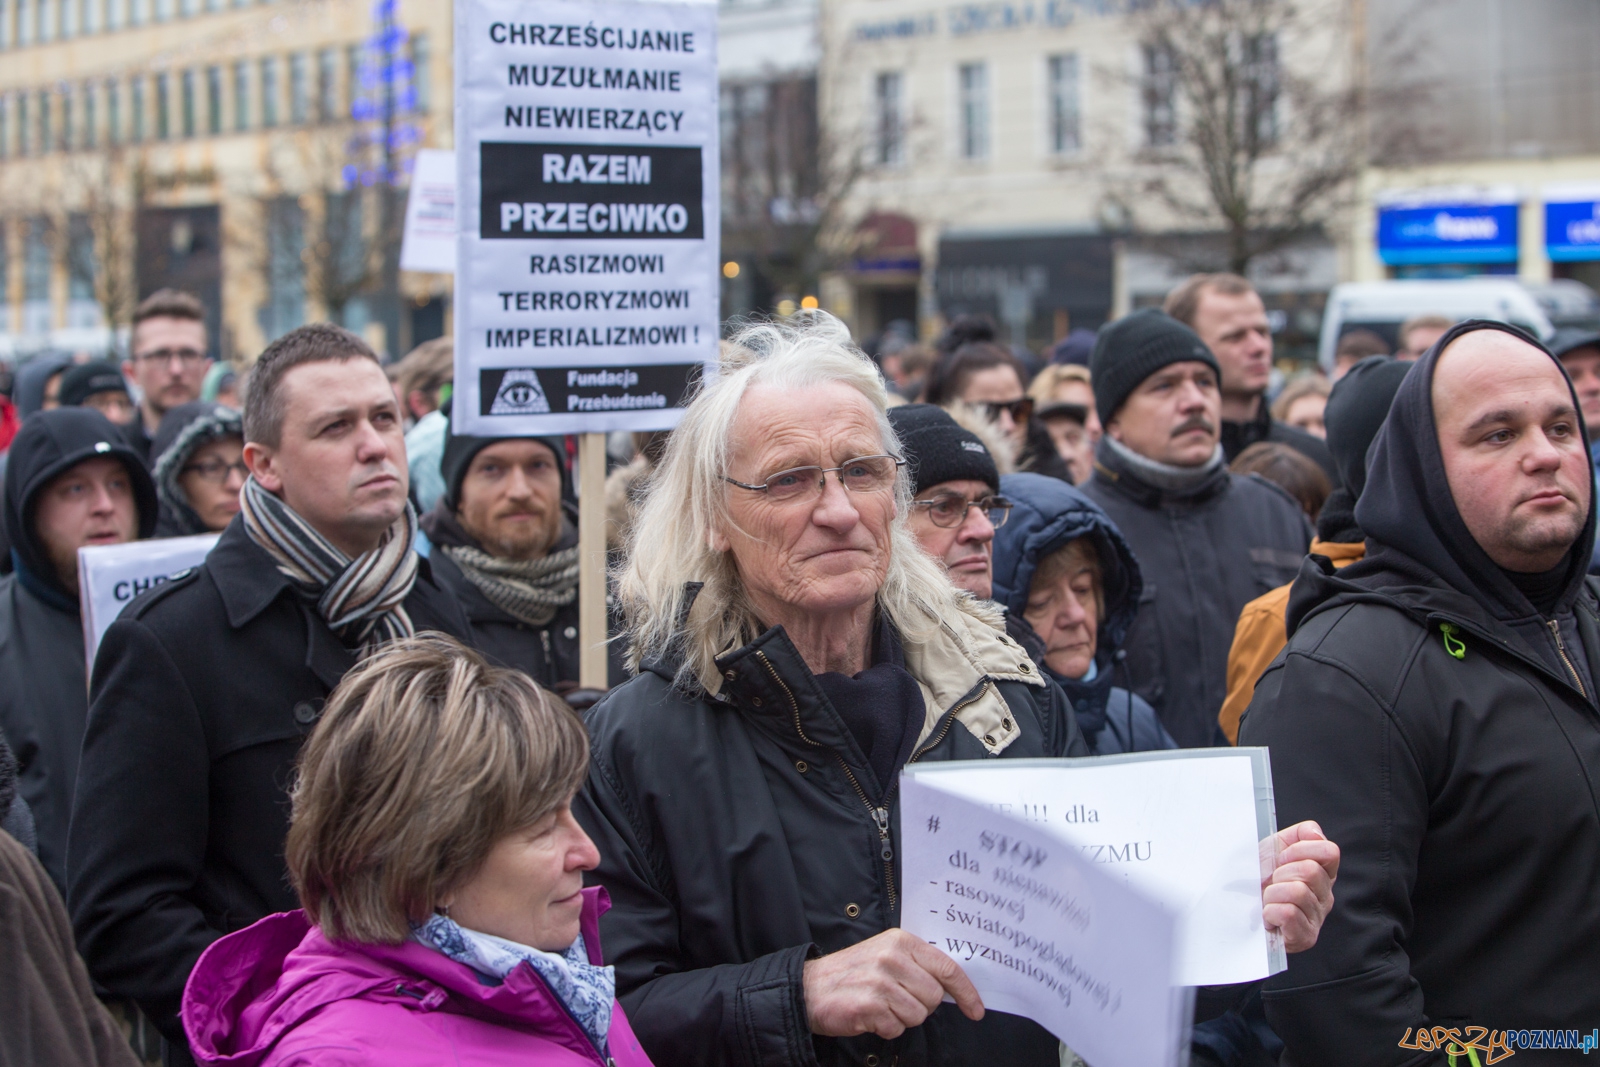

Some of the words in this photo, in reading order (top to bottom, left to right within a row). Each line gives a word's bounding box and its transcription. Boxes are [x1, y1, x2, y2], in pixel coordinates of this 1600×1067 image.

[489, 21, 695, 53] CHRZEŚCIJANIE
[508, 64, 682, 92] MUZUŁMANIE
[504, 106, 684, 137] NIEWIERZĄCY
[542, 153, 652, 184] RAZEM
[500, 202, 689, 233] PRZECIWKO
[530, 254, 664, 275] RASIZMOWI
[498, 290, 690, 311] TERRORYZMOWI
[486, 326, 687, 348] IMPERIALIZMOWI
[567, 369, 639, 389] Fundacja
[567, 392, 667, 411] Przebudzenie
[927, 815, 941, 834] #
[1065, 804, 1101, 824] dla
[949, 850, 981, 874] dla
[945, 879, 1025, 924] rasowej
[945, 937, 1072, 1008] wyznaniowej
